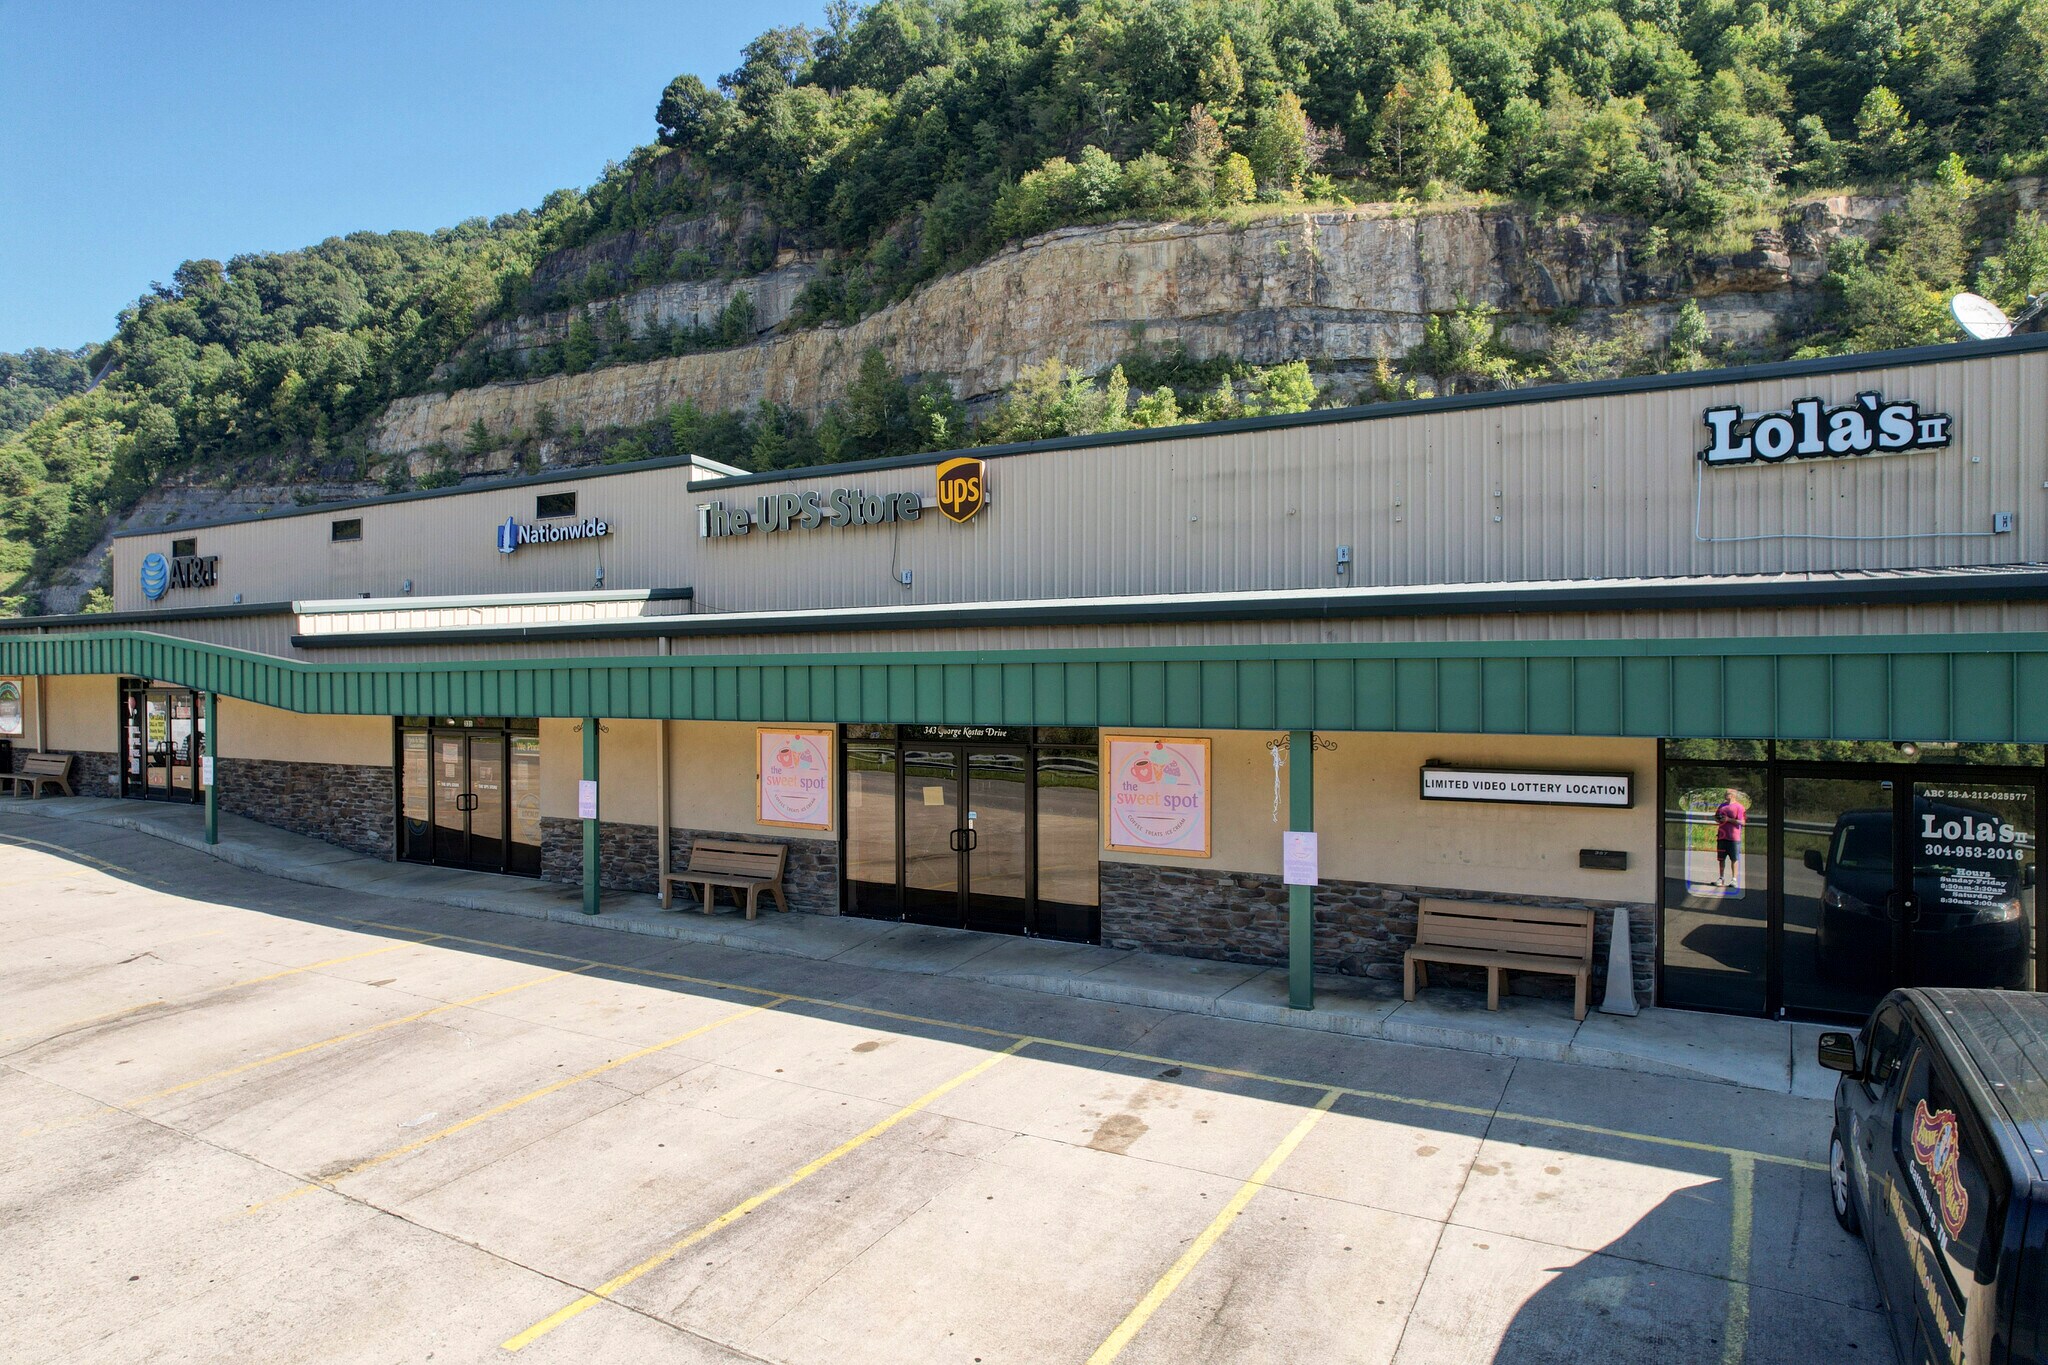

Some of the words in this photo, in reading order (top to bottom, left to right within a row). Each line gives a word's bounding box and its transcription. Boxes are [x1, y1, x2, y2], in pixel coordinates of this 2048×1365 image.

[1708, 396, 1914, 461] Lola's
[1918, 418, 1947, 443] II
[940, 477, 979, 512] ups
[697, 500, 749, 538] The
[757, 491, 823, 533] UPS
[830, 488, 921, 528] Store
[519, 517, 608, 544] Nationwide
[169, 556, 218, 589] AT&T
[924, 726, 937, 735] 343
[963, 727, 984, 738] Kostas
[985, 727, 1007, 737] Drive
[771, 766, 782, 774] the
[767, 776, 797, 786] sweet
[800, 777, 824, 791] spot
[1122, 781, 1138, 791] the
[1425, 779, 1469, 789] LIMITED
[1472, 781, 1506, 791] VIDEO
[1510, 783, 1561, 793] LOTTERY
[1566, 784, 1626, 795] LOCATION
[1117, 792, 1160, 805] sweet
[1164, 793, 1199, 811] spot
[1923, 789, 1945, 798] ABC
[1947, 790, 2028, 801] 23-A-212-025577
[1172, 818, 1186, 832] CREAM
[1922, 814, 2015, 843] Lola's
[1925, 844, 2024, 860] 304-953-2016
[1956, 868, 1991, 877] Hours
[1940, 876, 2007, 887] Sunday-Friday
[1952, 891, 1994, 900] Saturday
